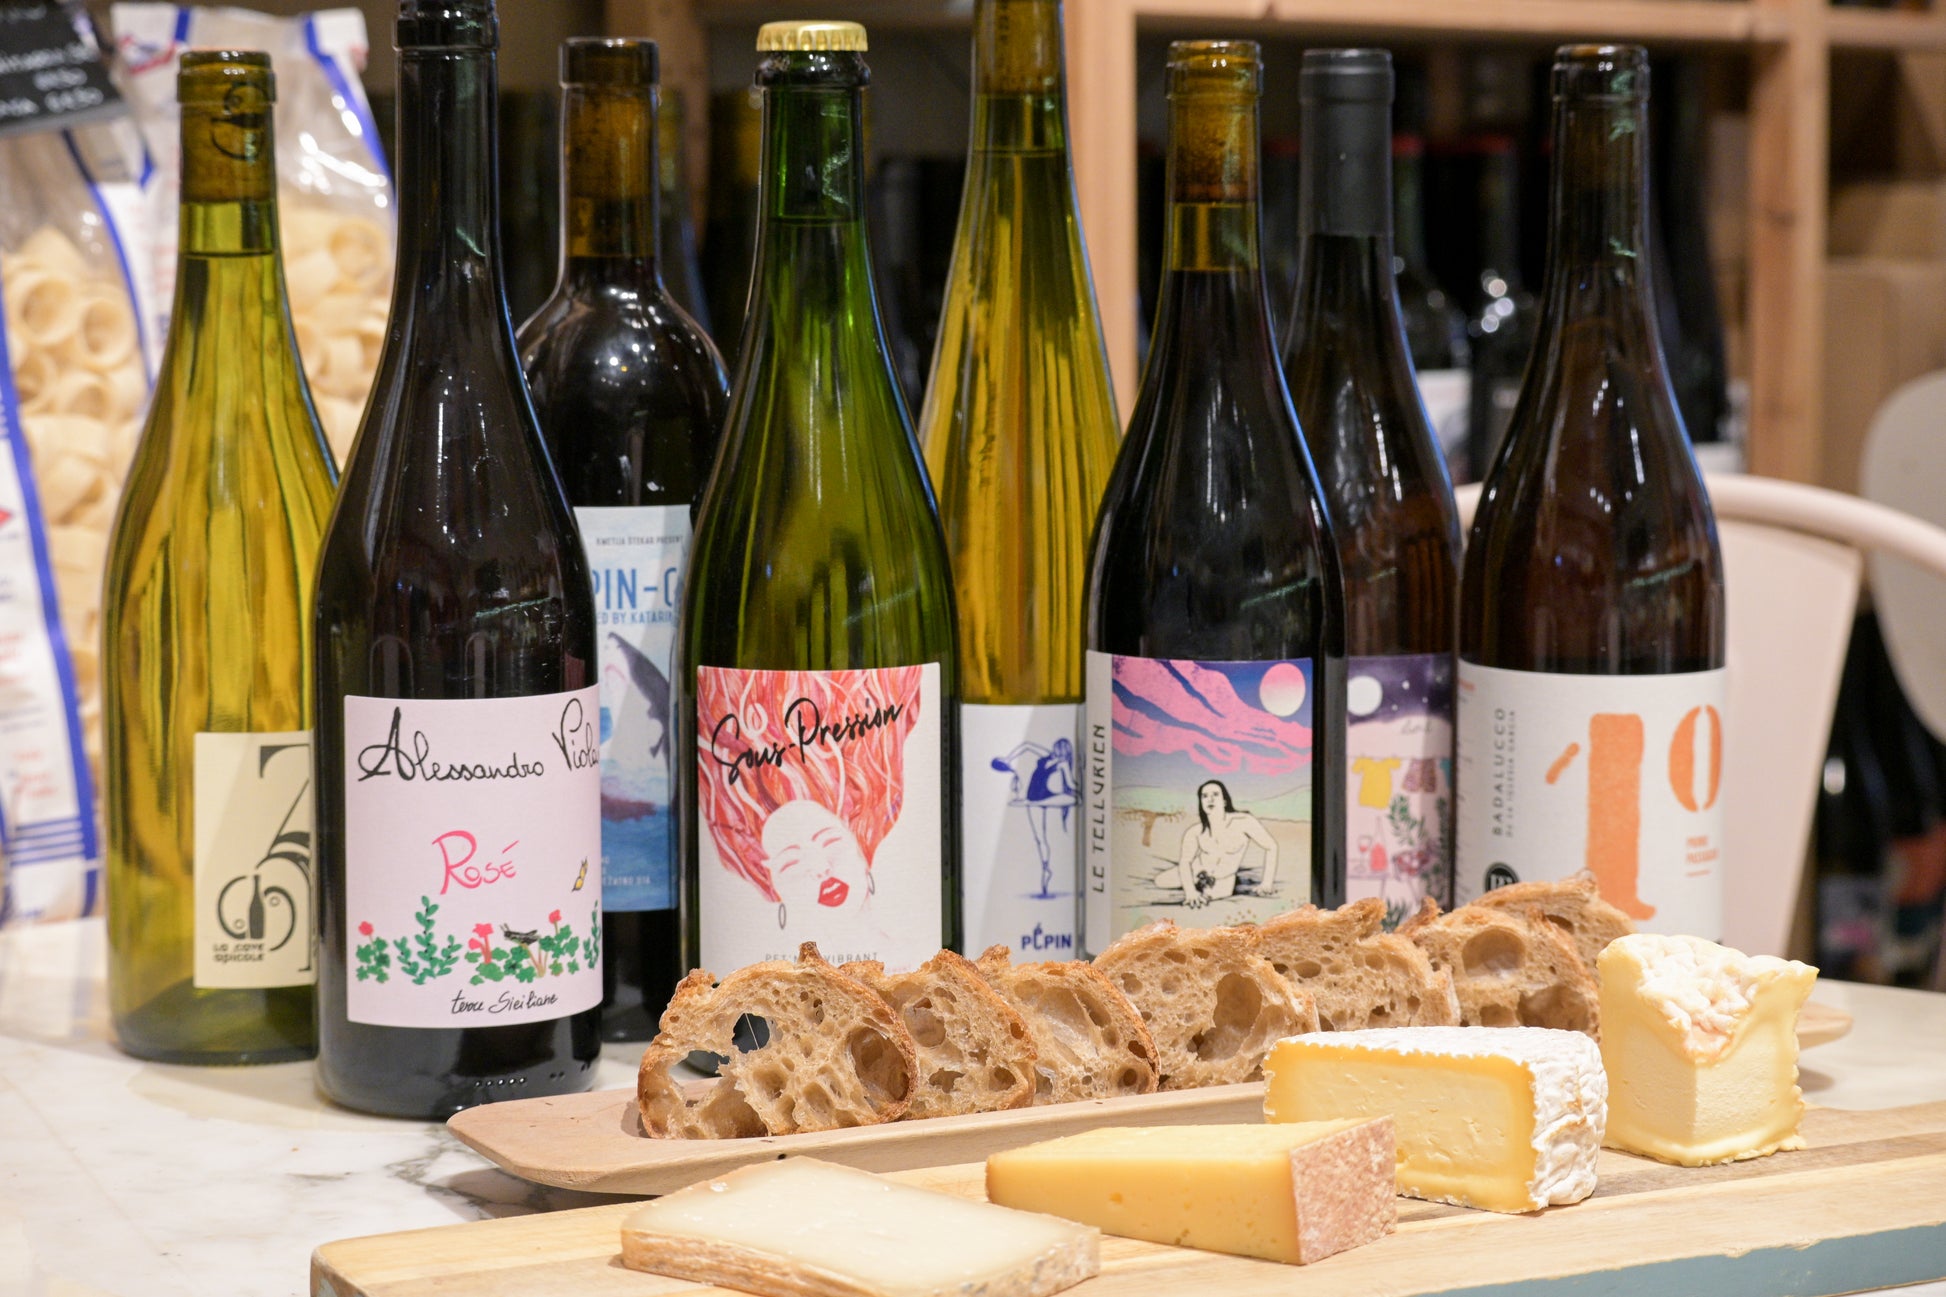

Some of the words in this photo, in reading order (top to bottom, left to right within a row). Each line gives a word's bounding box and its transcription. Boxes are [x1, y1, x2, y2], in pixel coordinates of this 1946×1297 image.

[612, 612, 626, 624] BY
[358, 706, 544, 782] Alessandro
[1492, 708, 1506, 836] BADALUCCO
